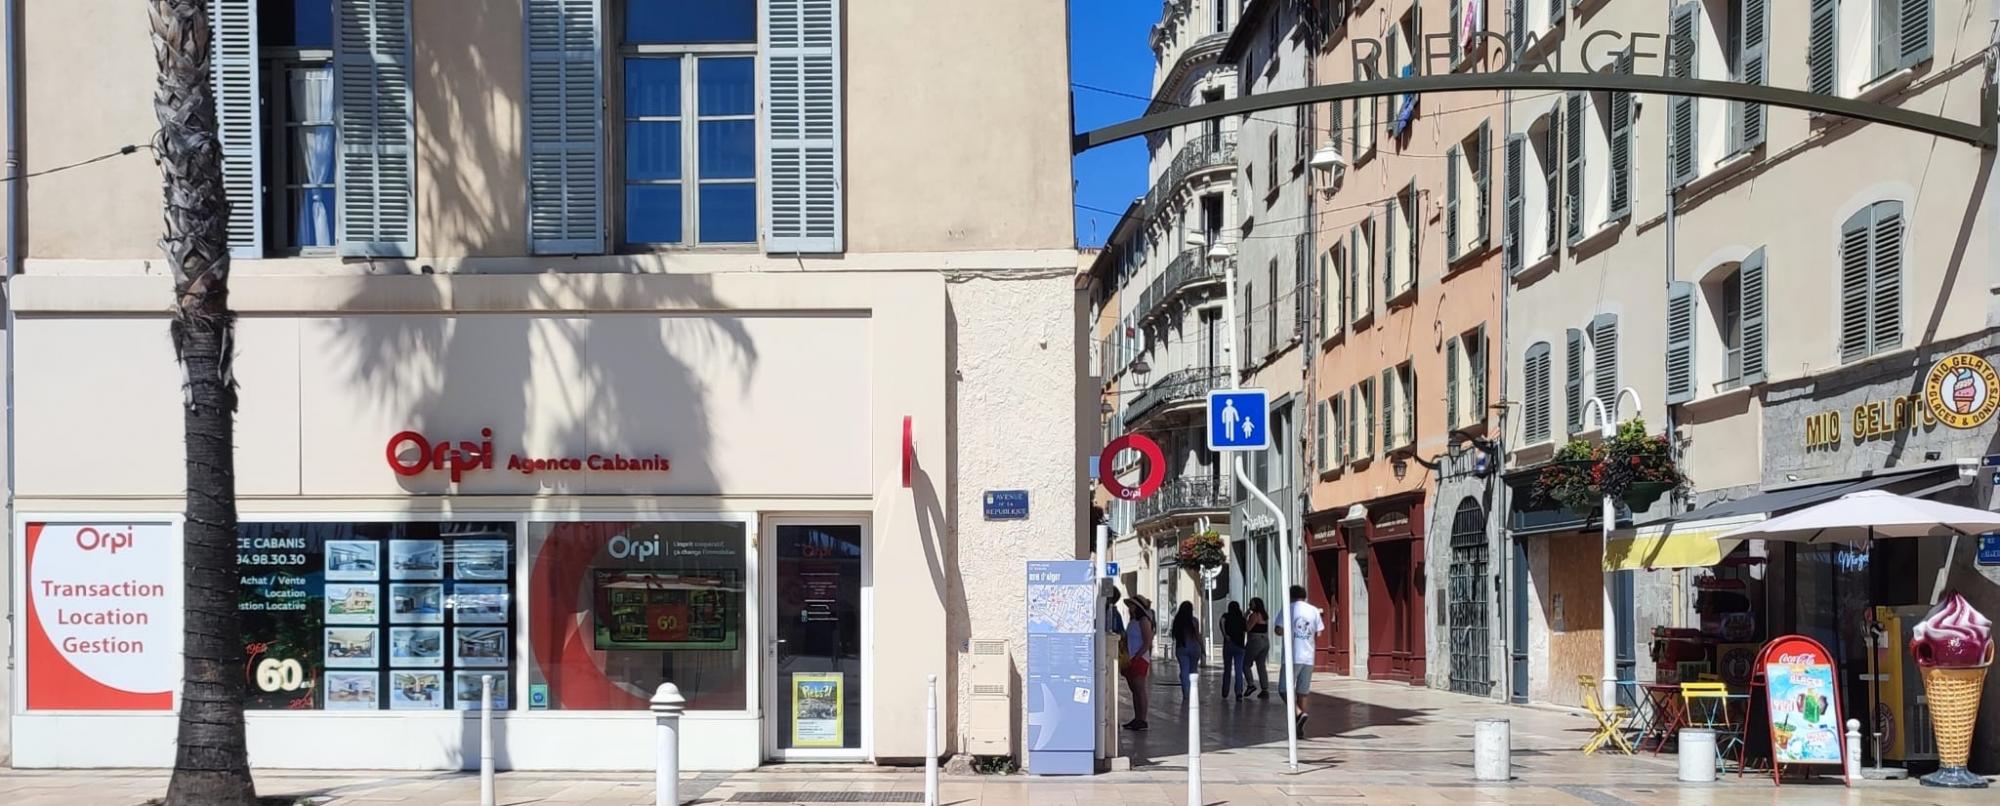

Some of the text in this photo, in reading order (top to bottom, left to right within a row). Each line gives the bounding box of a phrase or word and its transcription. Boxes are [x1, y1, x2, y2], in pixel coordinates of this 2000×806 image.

[1351, 32, 1452, 82] RUE
[1930, 355, 1995, 386] MIO GELATO
[1928, 386, 1999, 426] GLACES & DONUTS
[1806, 410, 1841, 447] MIO
[386, 427, 670, 483] Orpi Agence Cabanis
[1121, 488, 1141, 499] Orpi
[76, 525, 133, 554] Orpi
[253, 537, 306, 549] CABANIS
[608, 534, 660, 561] Orpi
[41, 580, 165, 597] Transaction
[240, 575, 268, 585] Achat
[278, 576, 306, 585] Vente
[265, 588, 306, 598] Location
[58, 608, 148, 625] Location
[266, 600, 306, 611] Locative
[63, 636, 144, 653] Gestion
[257, 658, 303, 692] 60
